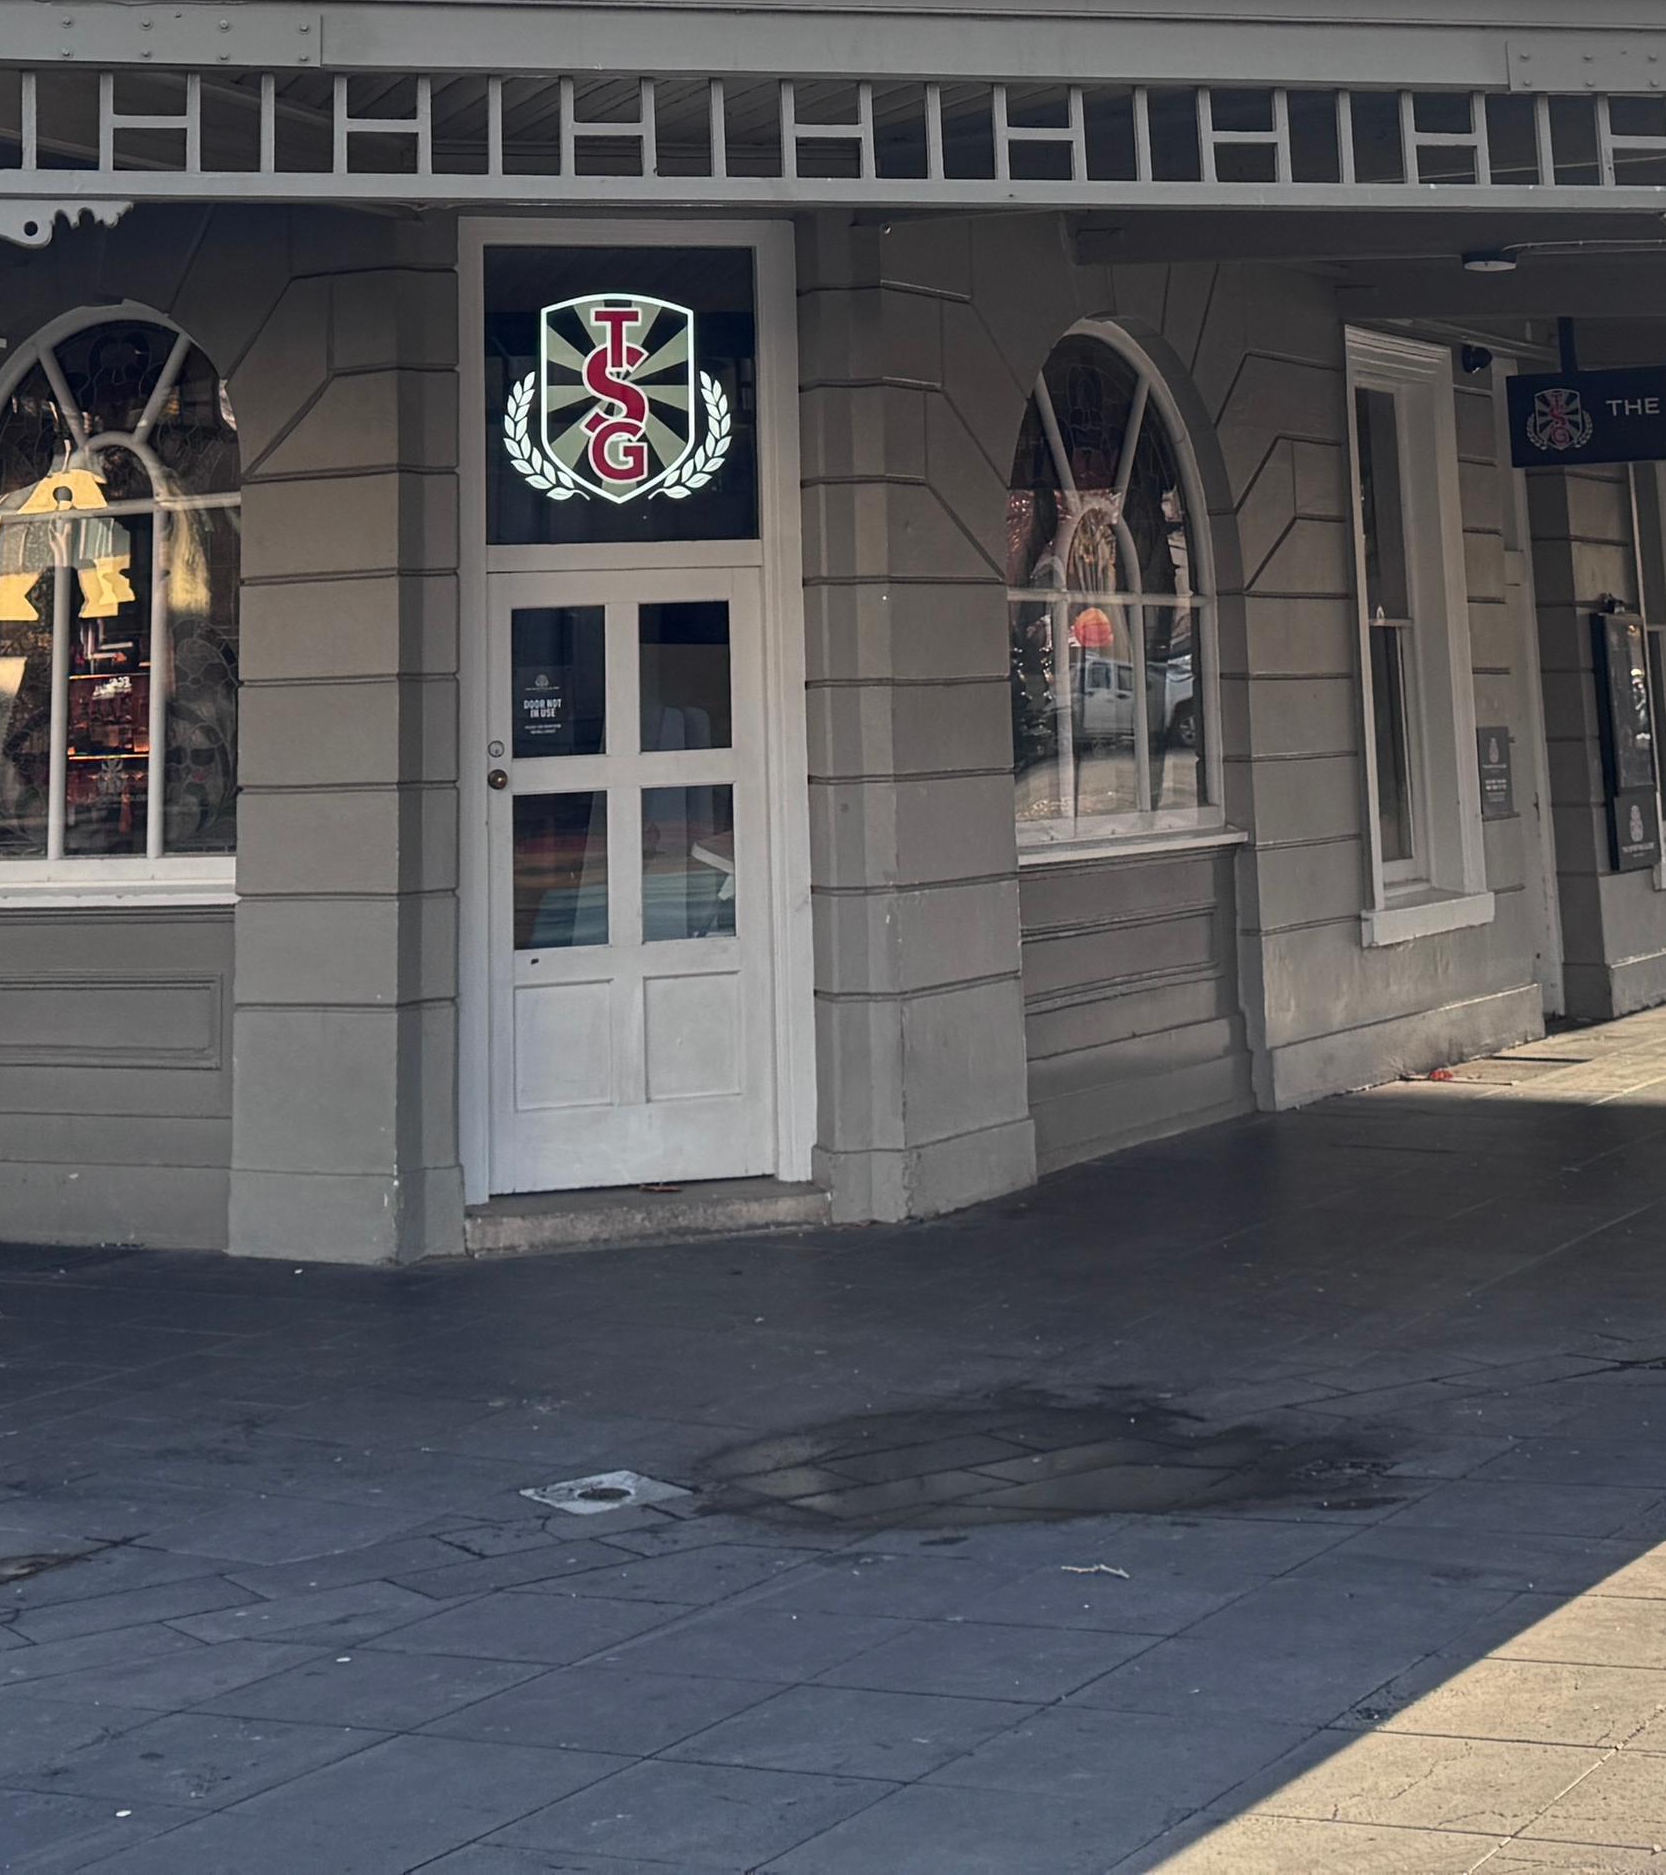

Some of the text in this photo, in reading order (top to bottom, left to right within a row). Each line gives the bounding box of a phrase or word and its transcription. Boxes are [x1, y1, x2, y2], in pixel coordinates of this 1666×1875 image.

[580, 307, 650, 484] TSG
[1606, 397, 1661, 417] THE
[523, 698, 562, 710] DOOR NOT
[540, 708, 556, 718] USE
